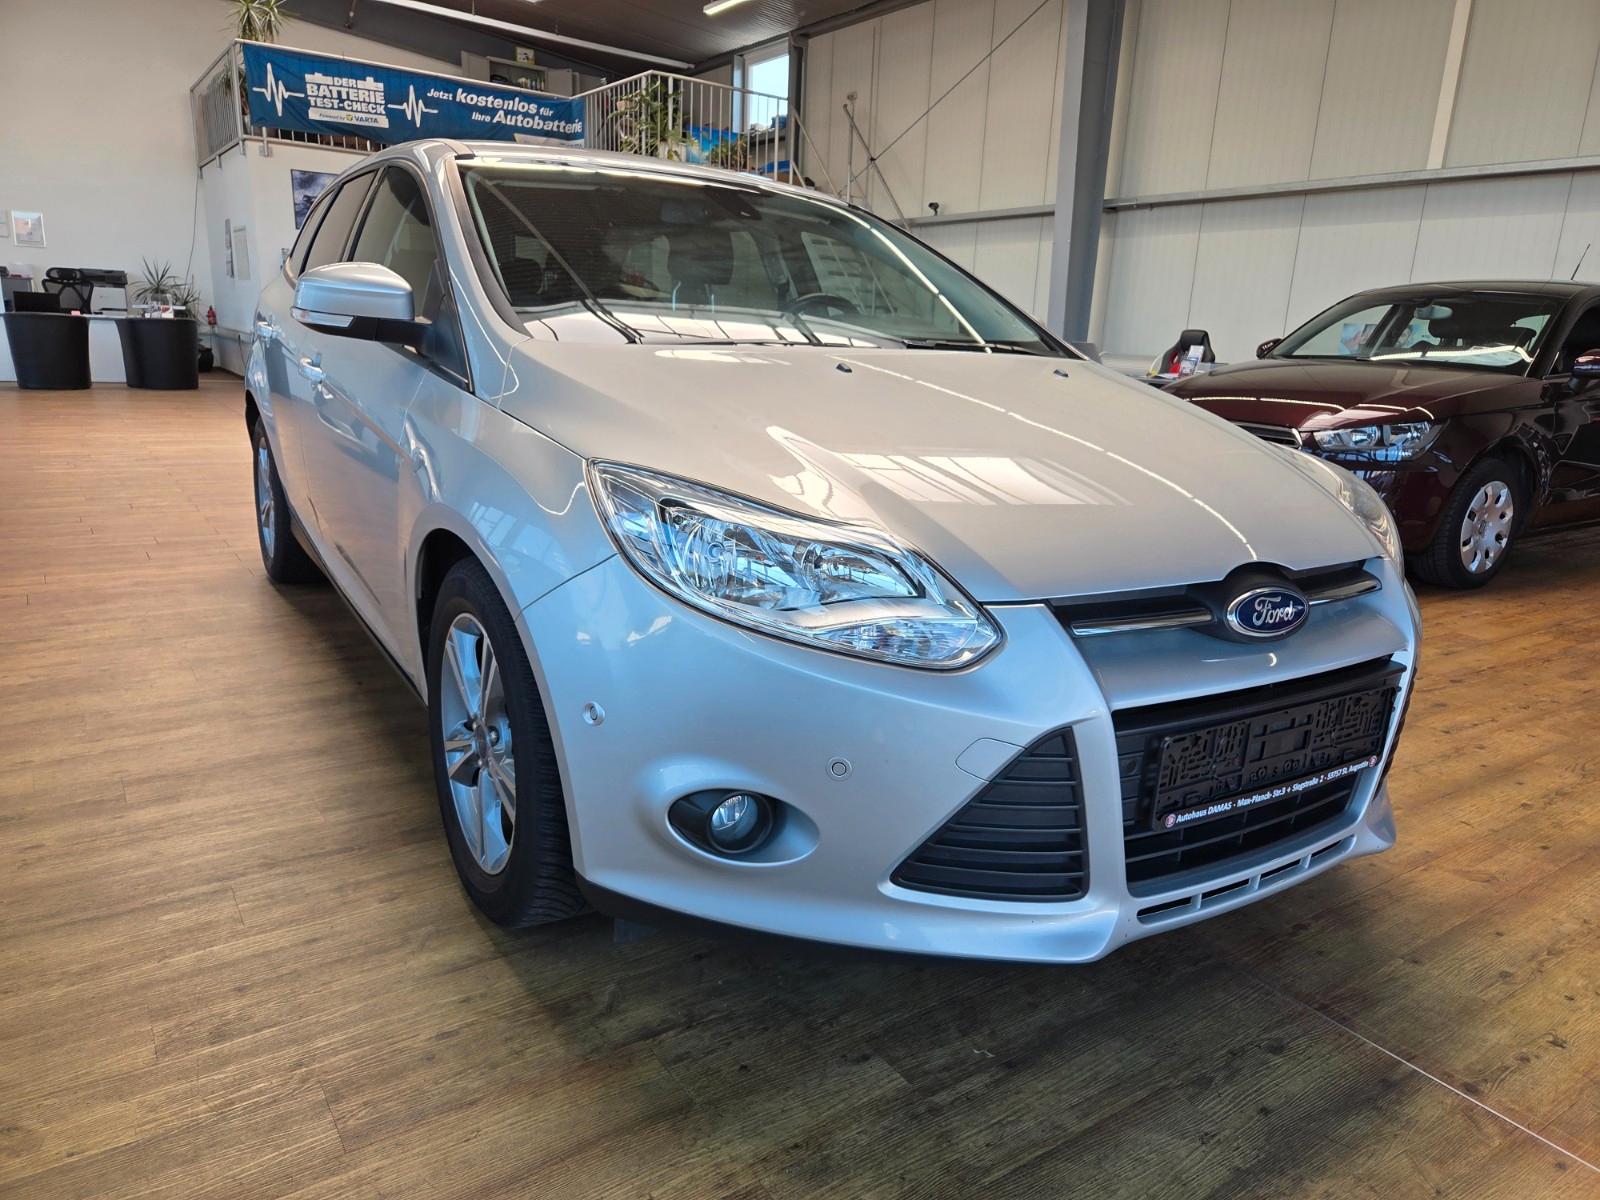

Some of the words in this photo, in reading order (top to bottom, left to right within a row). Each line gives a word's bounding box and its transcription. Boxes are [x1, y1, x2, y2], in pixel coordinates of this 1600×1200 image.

[333, 76, 357, 89] DER
[306, 83, 386, 105] BATTERIE
[427, 88, 453, 101] Jetzt
[456, 87, 538, 114] kostenlos
[539, 106, 554, 117] für
[307, 96, 386, 115] TEST-CHECK
[354, 114, 380, 124] VARTA
[472, 111, 491, 123] Ihre
[1252, 595, 1304, 627] Ford
[1175, 809, 1208, 824] Autohaus
[1207, 801, 1233, 815] DAMAS
